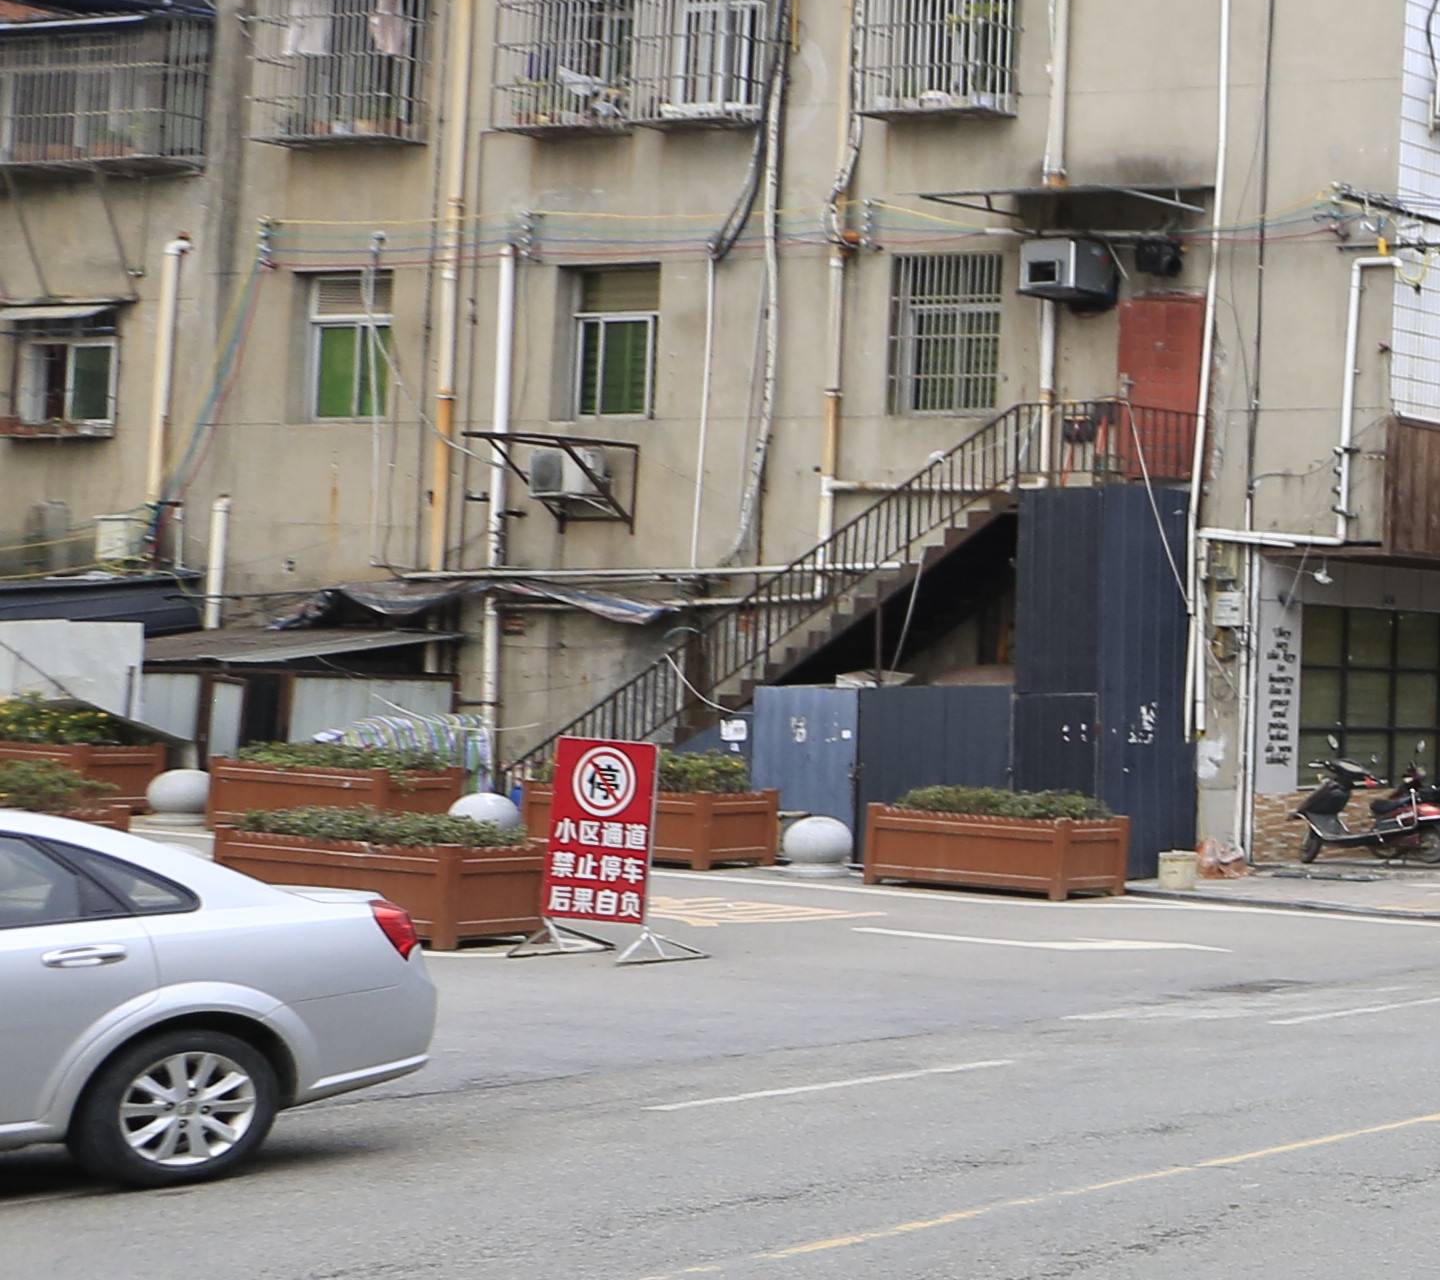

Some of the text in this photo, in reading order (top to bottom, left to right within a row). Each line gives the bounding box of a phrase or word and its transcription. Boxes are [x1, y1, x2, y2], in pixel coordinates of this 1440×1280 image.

[588, 764, 622, 801] 停
[555, 818, 648, 850] 小区通道
[552, 852, 644, 884] 禁止停车
[549, 887, 641, 918] 后果自负
